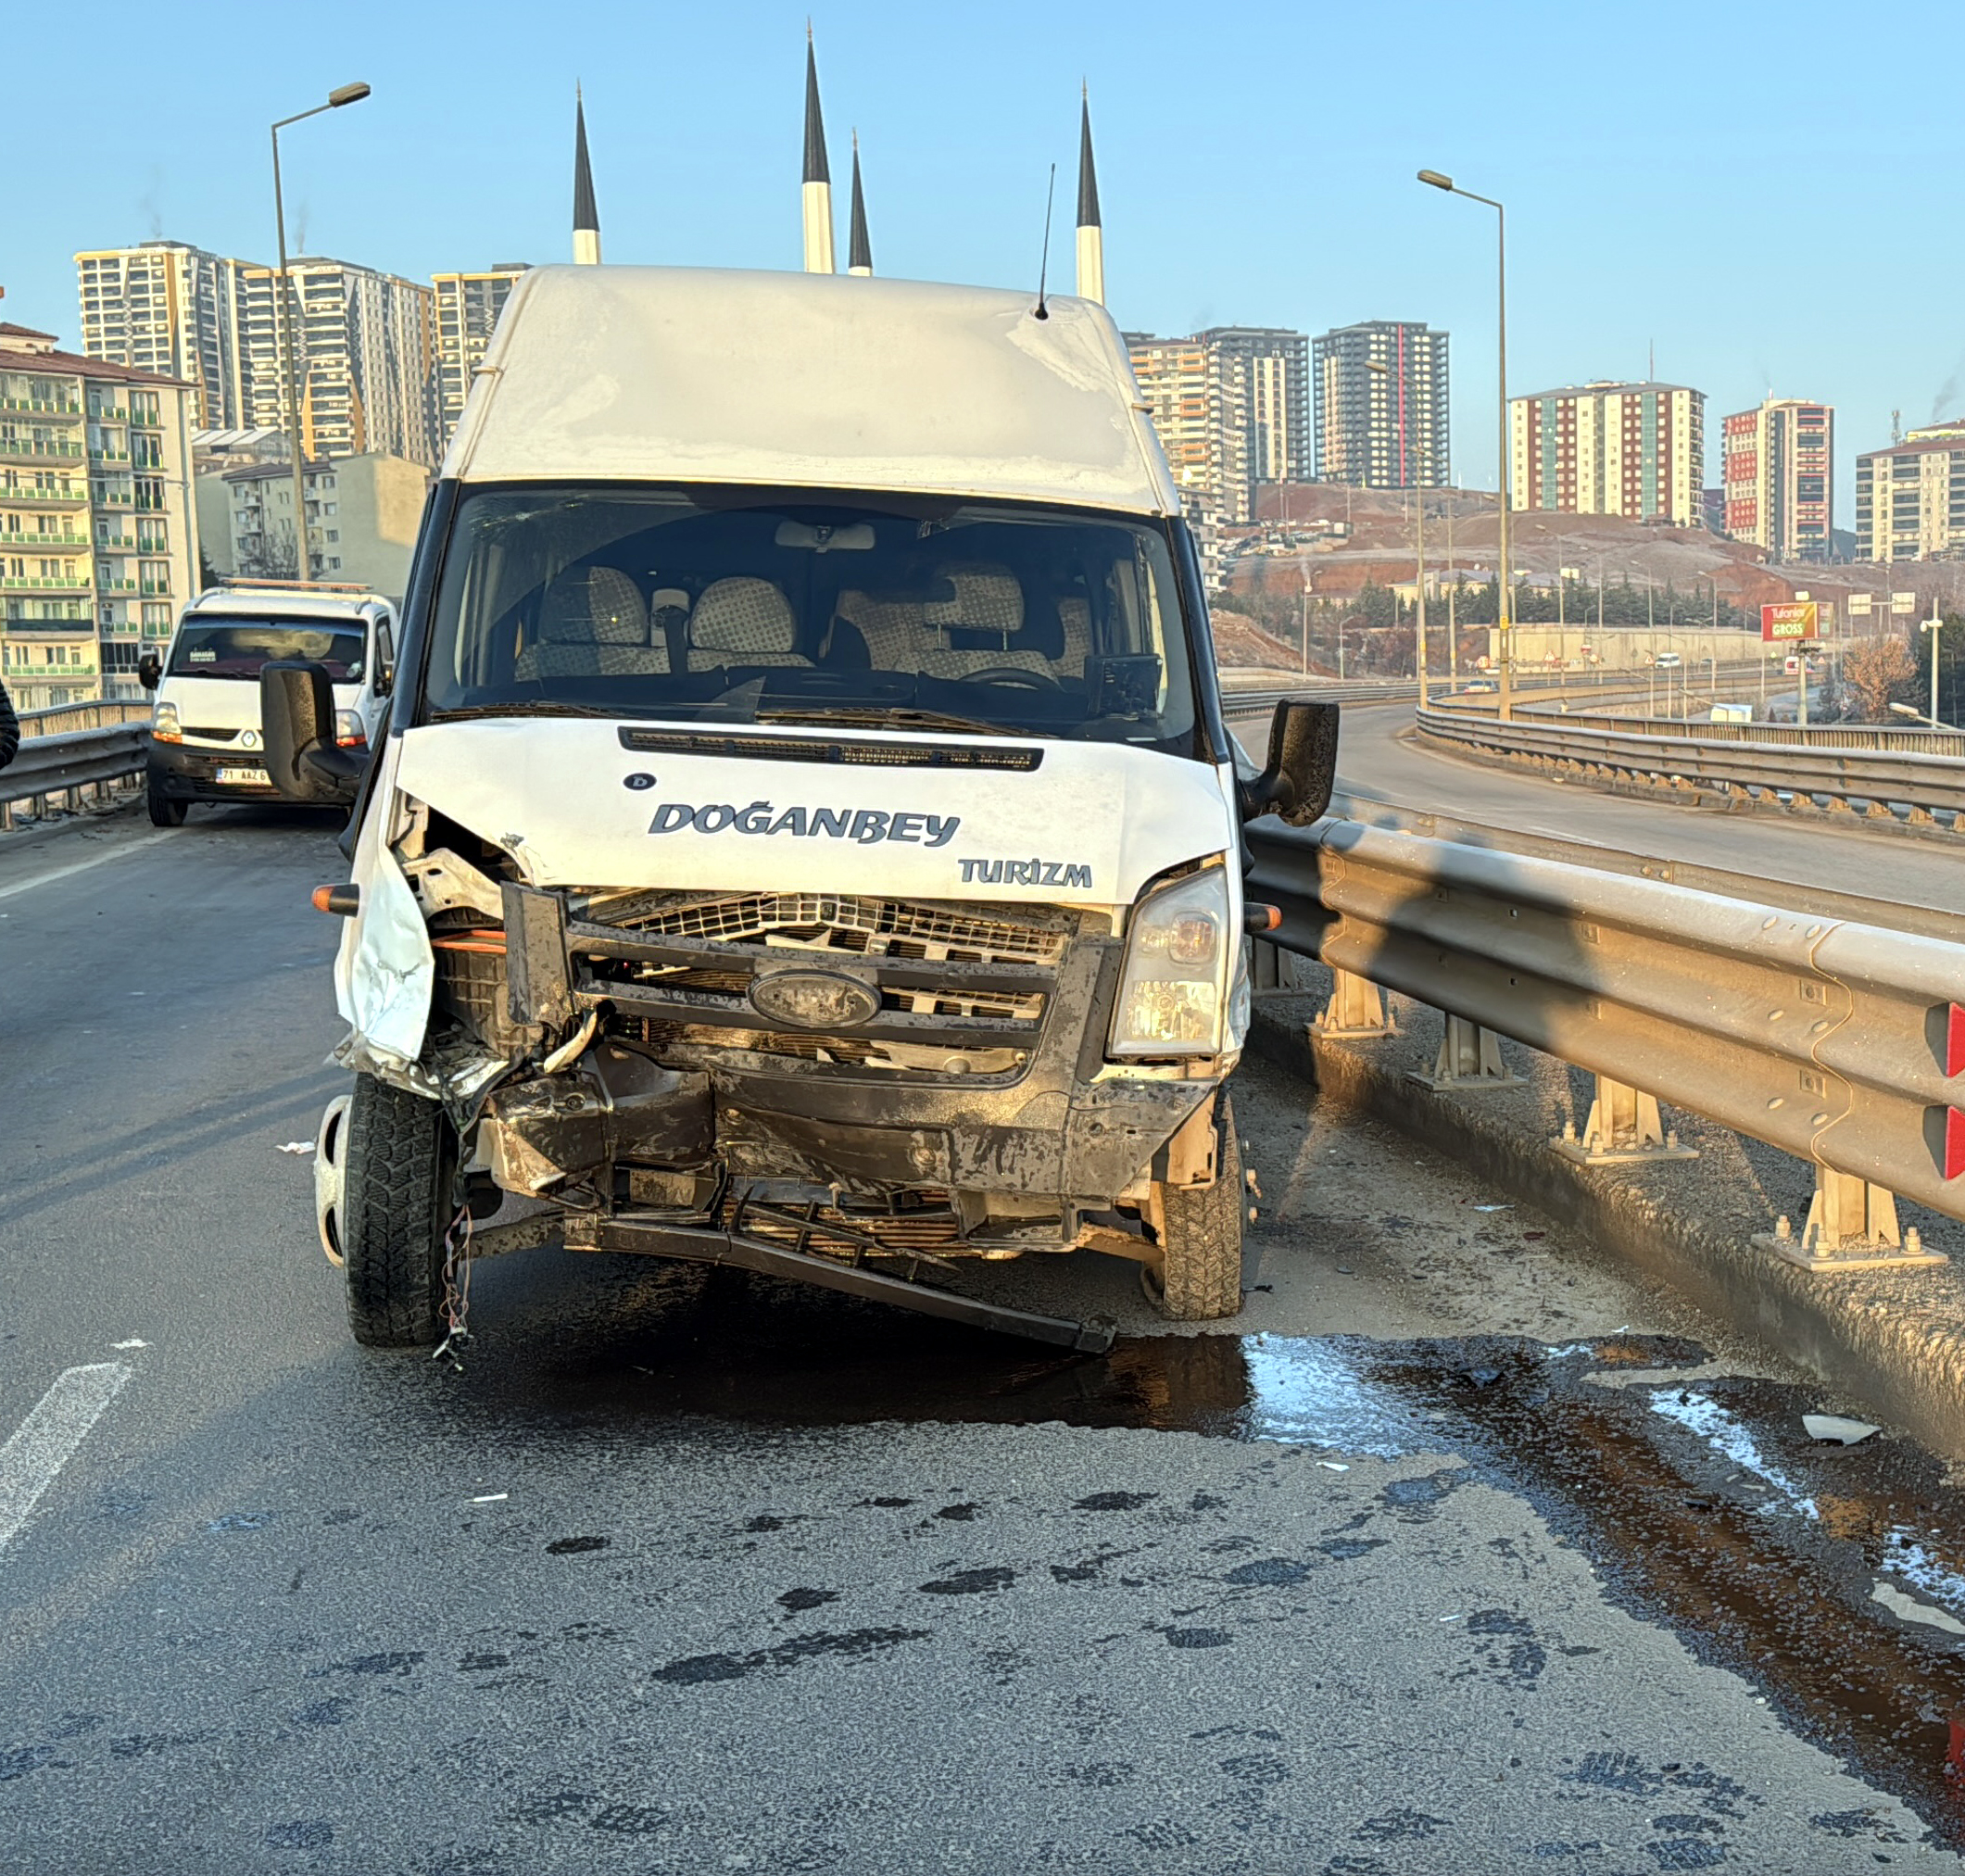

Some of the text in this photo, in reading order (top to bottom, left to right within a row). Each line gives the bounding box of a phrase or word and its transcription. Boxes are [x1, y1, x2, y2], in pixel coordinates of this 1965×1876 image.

[1772, 623, 1803, 636] GROSS
[223, 770, 233, 779] 71
[241, 771, 258, 780] AAZ
[648, 801, 961, 847] DOĞANBEY
[957, 858, 1093, 889] TURİZM
